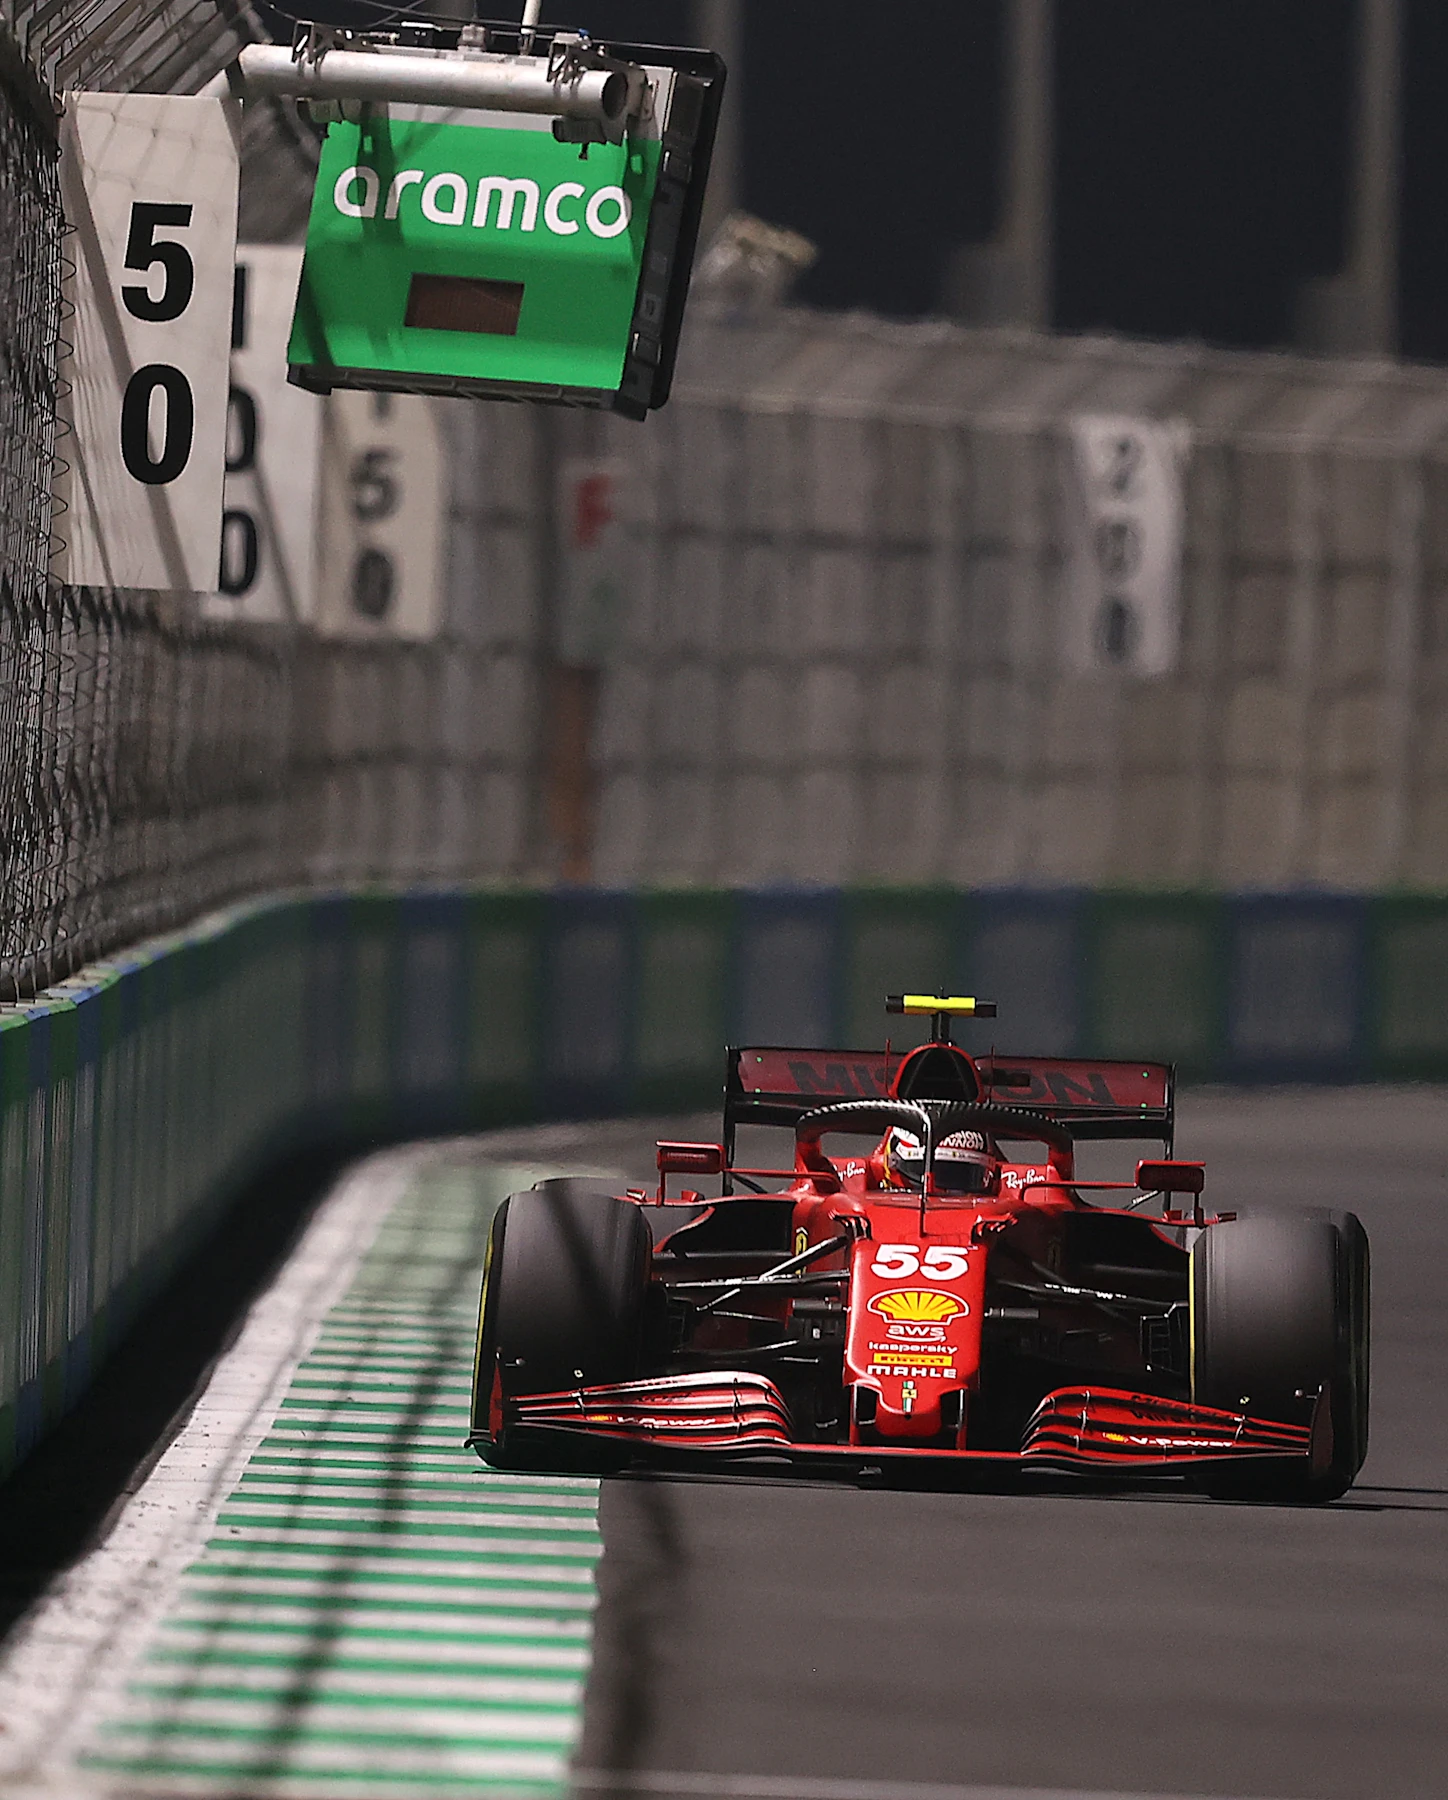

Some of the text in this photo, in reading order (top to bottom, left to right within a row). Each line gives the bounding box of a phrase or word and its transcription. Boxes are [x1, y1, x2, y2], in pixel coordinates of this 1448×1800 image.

[334, 165, 633, 238] aramco
[1001, 1168, 1046, 1190] Ray-Ban
[871, 1243, 969, 1281] 55
[887, 1323, 946, 1338] aws
[868, 1341, 959, 1355] kaspersky
[867, 1365, 957, 1379] MAHLE
